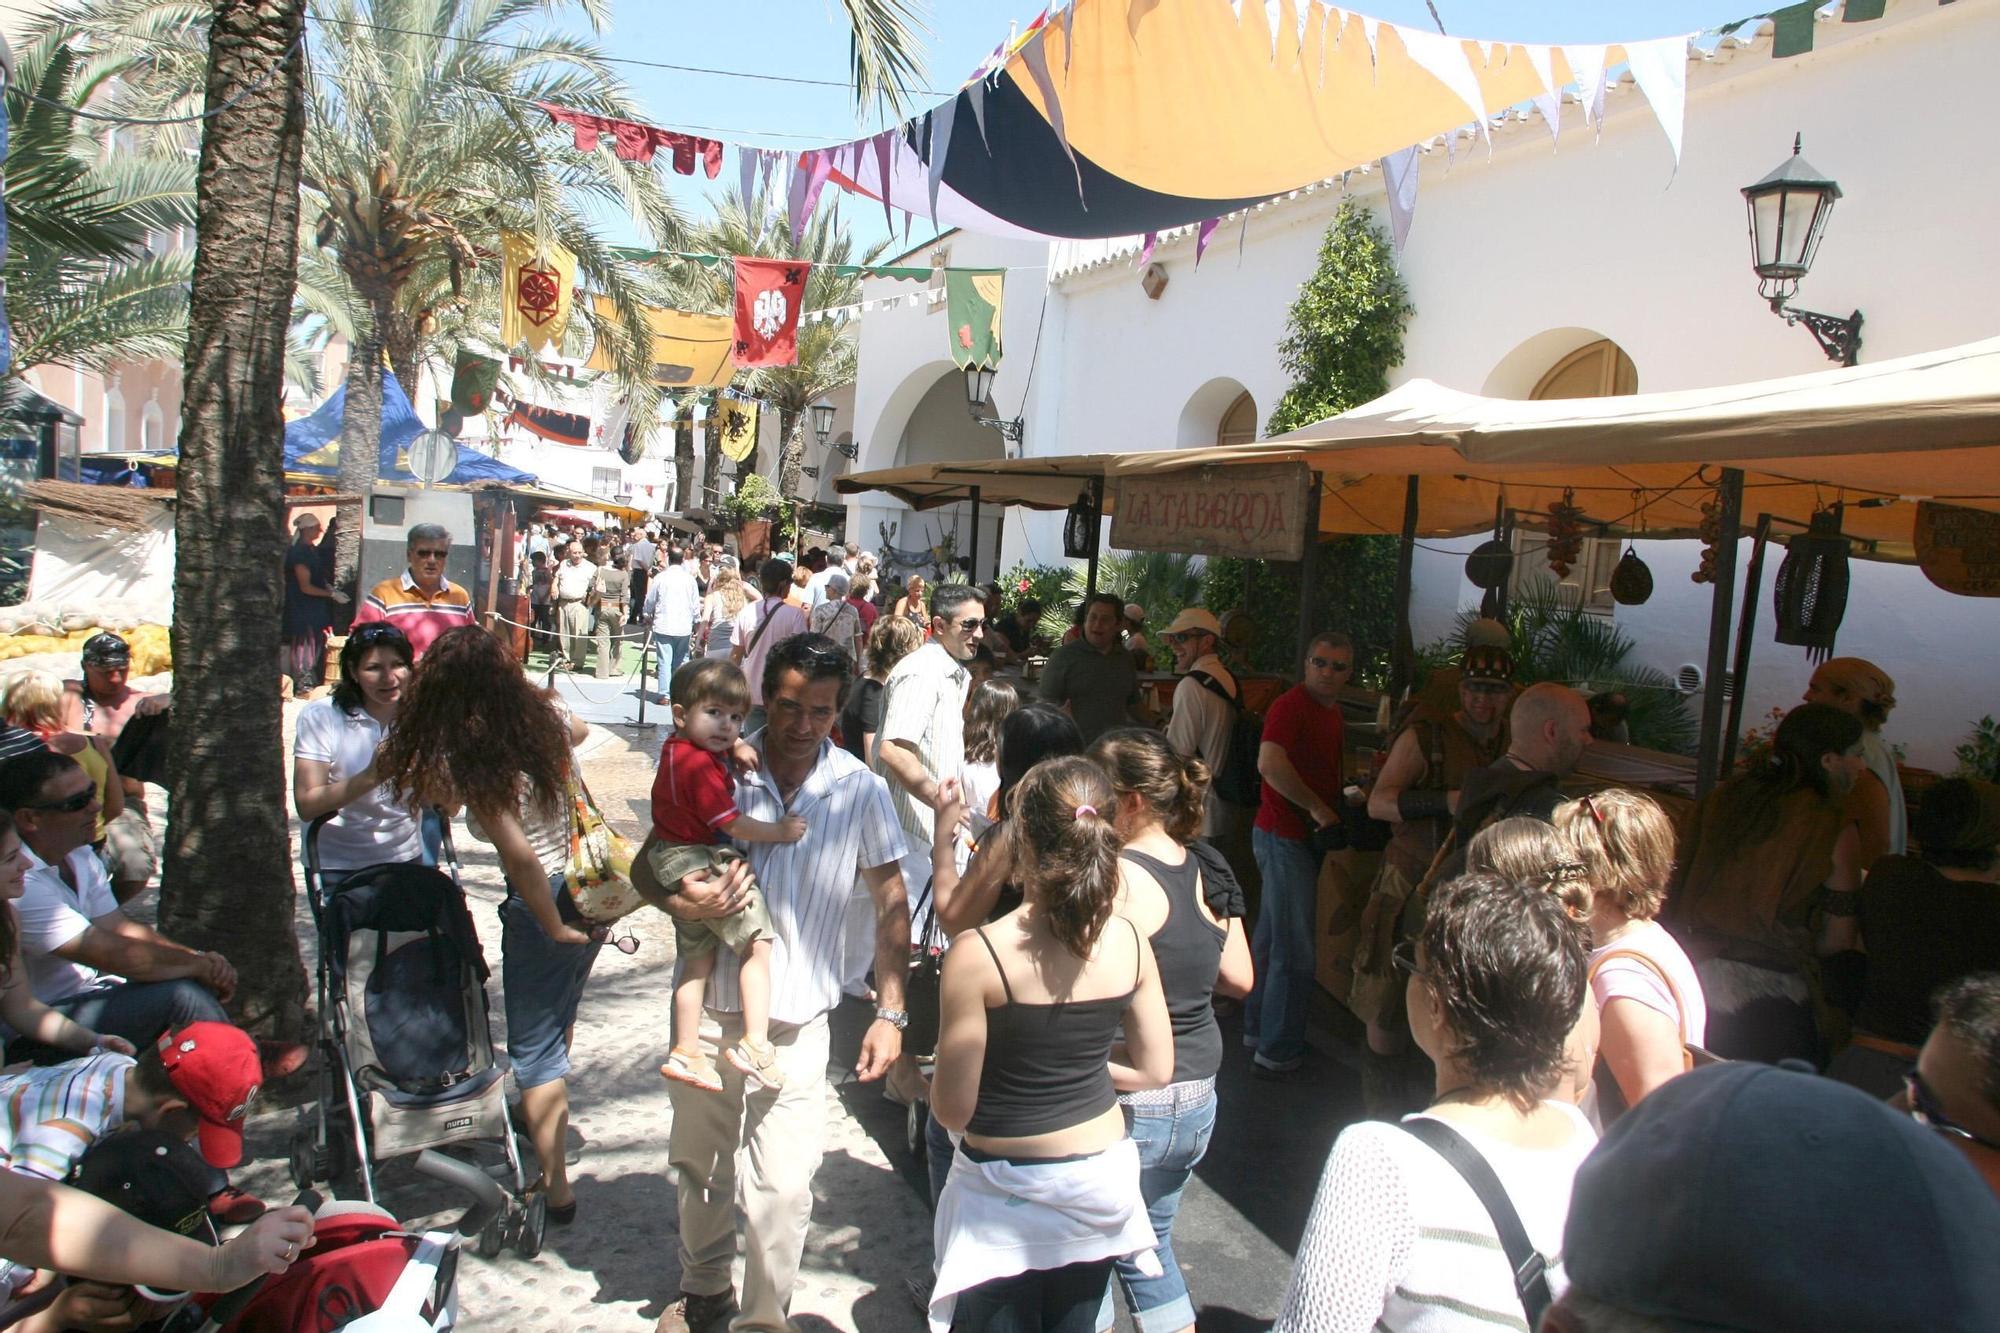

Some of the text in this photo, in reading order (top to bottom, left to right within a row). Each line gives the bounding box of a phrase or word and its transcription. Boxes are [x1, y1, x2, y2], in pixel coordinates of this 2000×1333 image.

[1126, 488, 1287, 544] LA TABERNA
[446, 1118, 470, 1129] nurse
